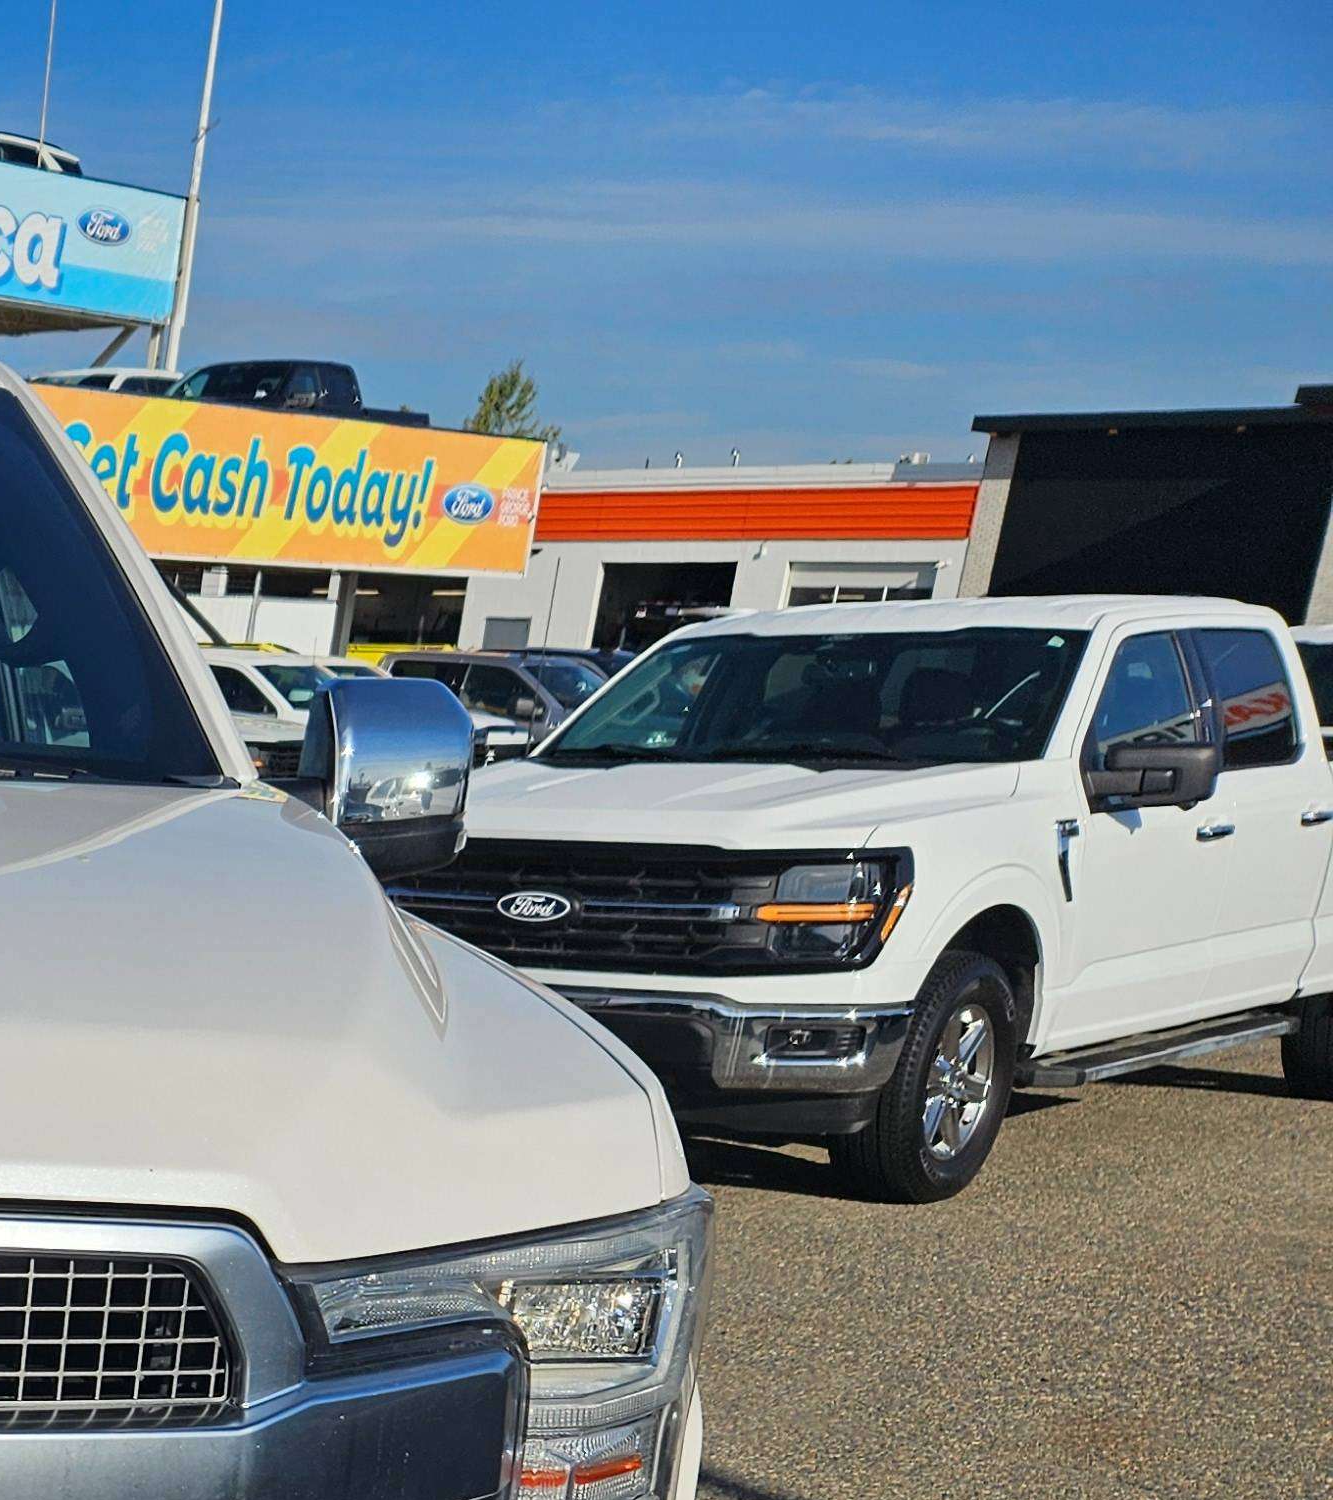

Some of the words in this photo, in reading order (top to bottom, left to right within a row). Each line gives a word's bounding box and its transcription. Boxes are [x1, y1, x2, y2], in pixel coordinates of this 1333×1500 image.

[86, 210, 122, 241] Ford
[152, 433, 270, 519] Cash
[284, 446, 435, 548] Today!
[451, 488, 486, 518] Ford
[510, 896, 557, 917] Ford
